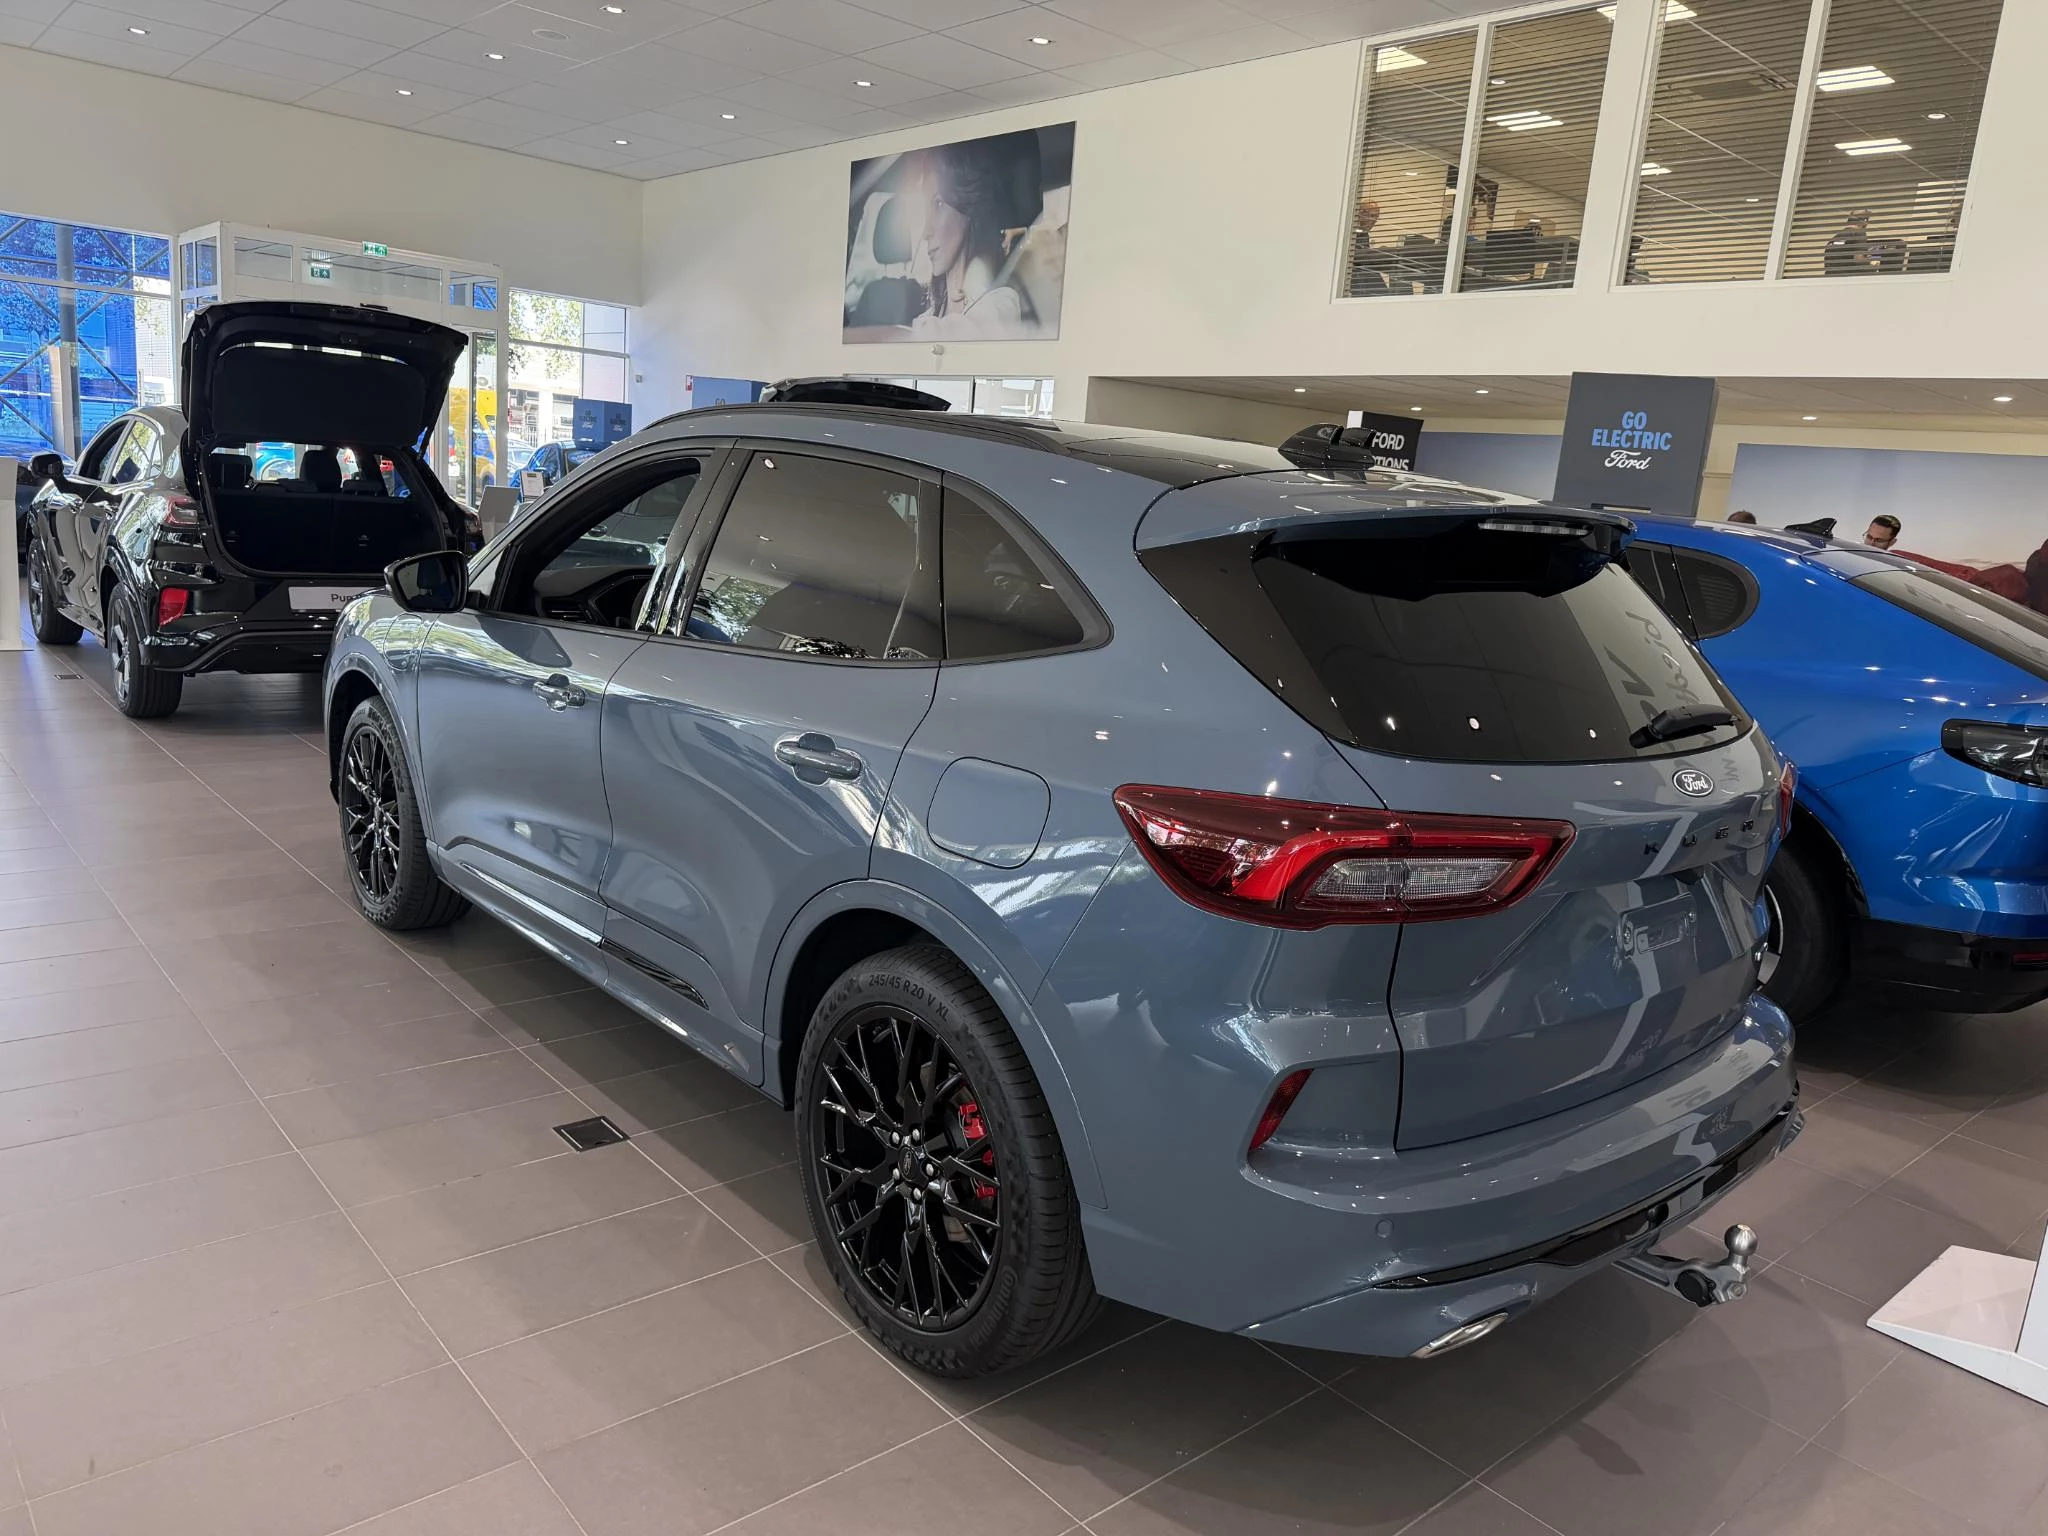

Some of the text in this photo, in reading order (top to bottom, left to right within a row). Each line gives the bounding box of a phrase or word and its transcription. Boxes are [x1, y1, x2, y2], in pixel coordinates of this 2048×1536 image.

[1622, 411, 1647, 430] GO
[1371, 431, 1405, 450] FORD
[1591, 428, 1672, 450] ELECTRIC
[1604, 449, 1652, 470] Ford
[1681, 773, 1710, 792] Ford
[868, 974, 949, 1021] 245/45 R 20 V XL
